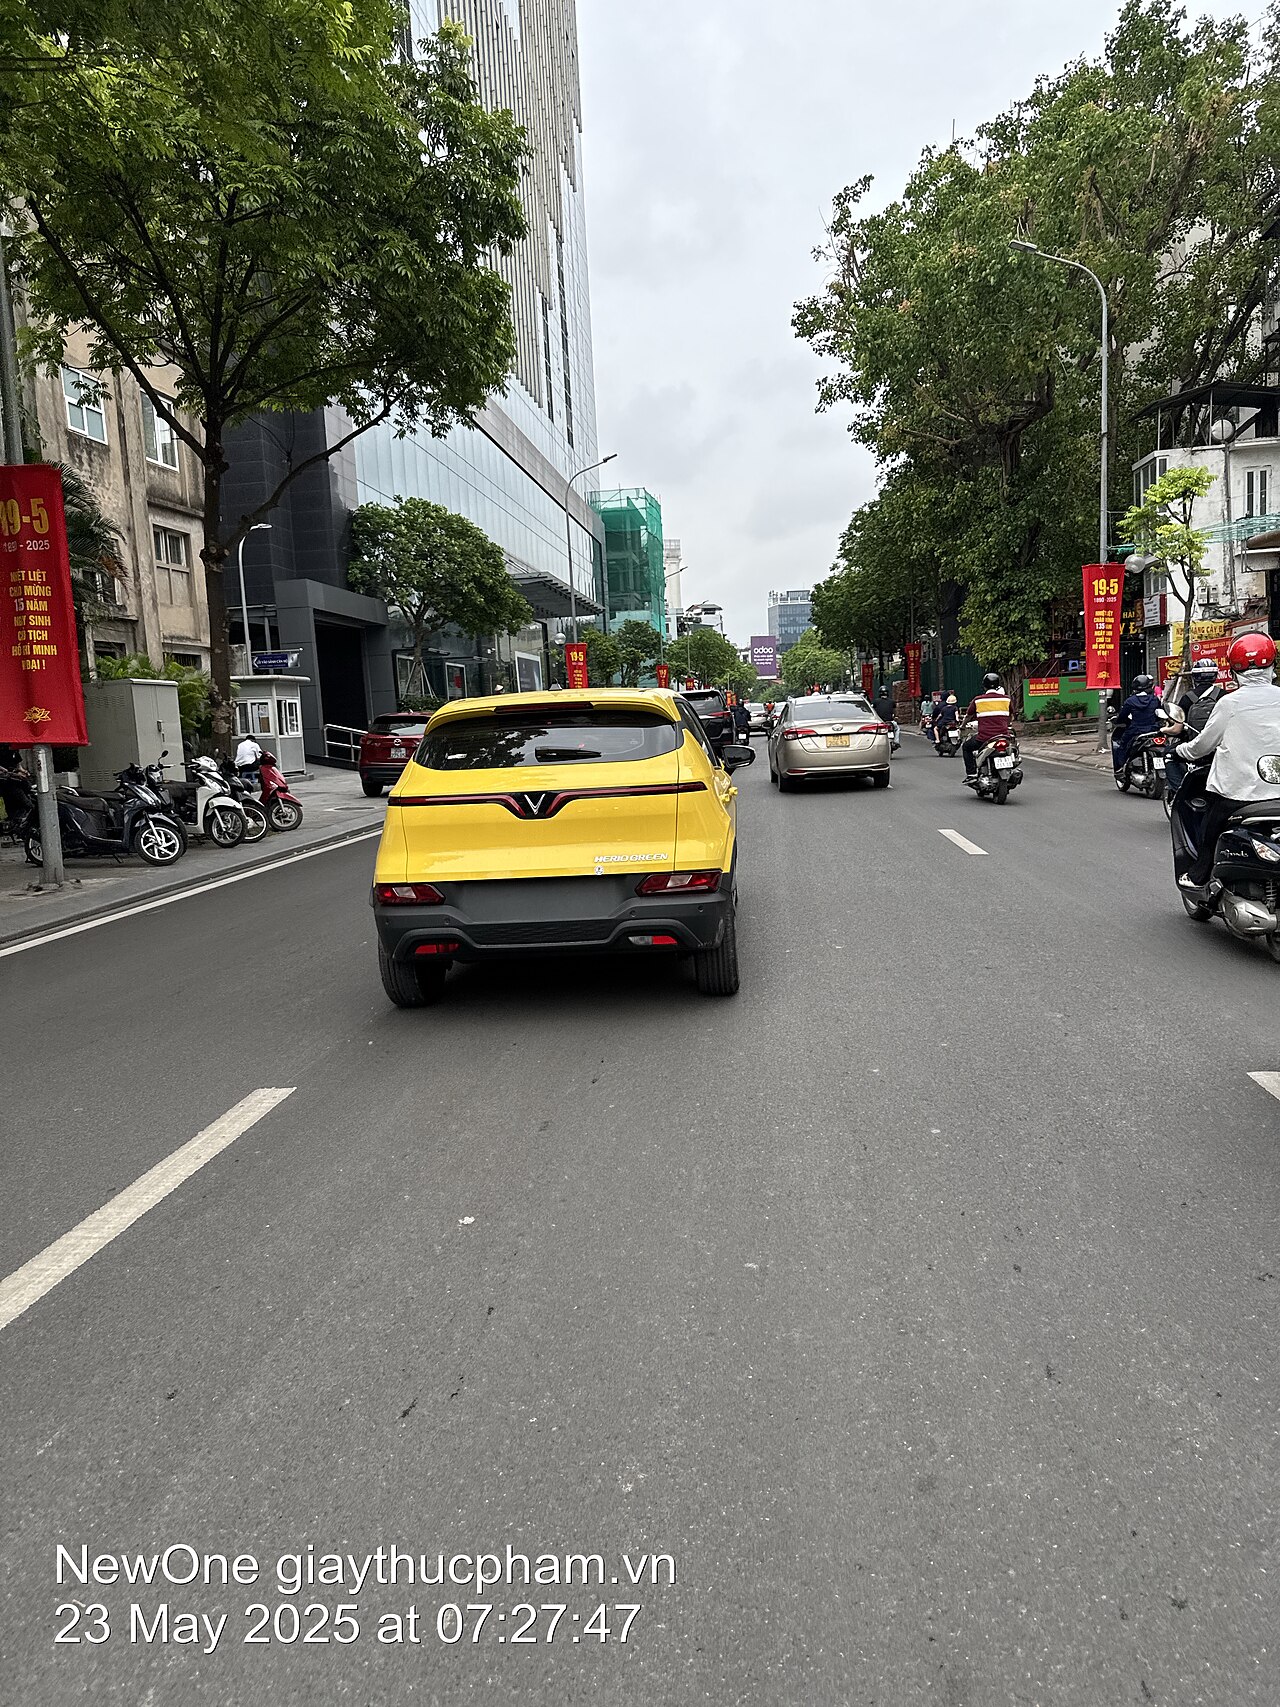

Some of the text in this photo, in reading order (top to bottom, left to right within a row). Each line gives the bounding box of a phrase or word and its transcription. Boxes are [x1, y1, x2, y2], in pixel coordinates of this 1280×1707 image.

[26, 540, 50, 551] 2025
[28, 569, 47, 584] LIỆT
[24, 583, 52, 597] MỪNG
[1092, 578, 1119, 596] 19-5
[26, 599, 48, 611] NĂM
[29, 615, 51, 626] SINH
[28, 630, 48, 642] TỊCH
[33, 645, 57, 656] MINH
[753, 645, 774, 654] odoo
[594, 853, 669, 863] HERIO GREEN
